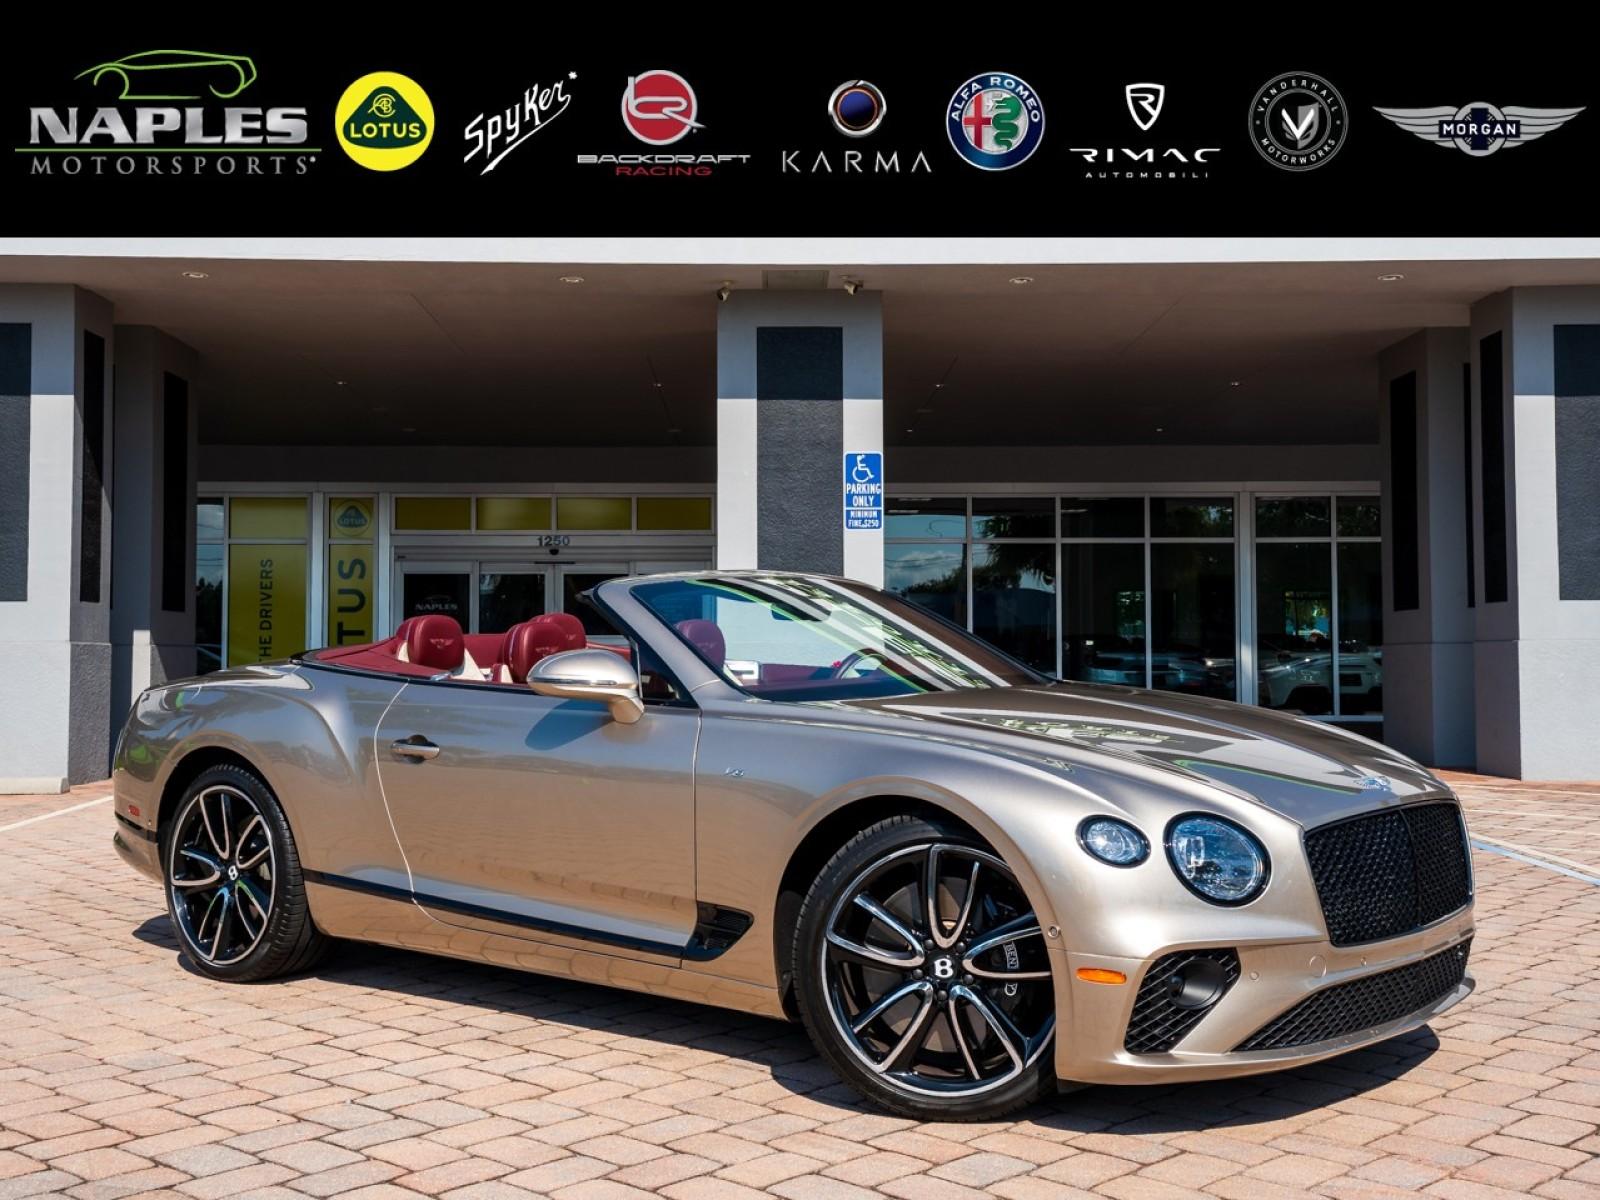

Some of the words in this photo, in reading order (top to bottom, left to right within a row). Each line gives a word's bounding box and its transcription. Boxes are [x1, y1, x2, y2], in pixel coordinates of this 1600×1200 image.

[846, 483, 881, 495] PARKING
[852, 495, 874, 507] ONLY
[850, 510, 878, 518] MINIMUM
[537, 535, 571, 547] 1250
[259, 558, 274, 631] DRIVERS
[337, 558, 367, 645] TUS
[415, 602, 458, 611] NAPLES
[259, 635, 273, 661] HE
[934, 958, 954, 978] B
